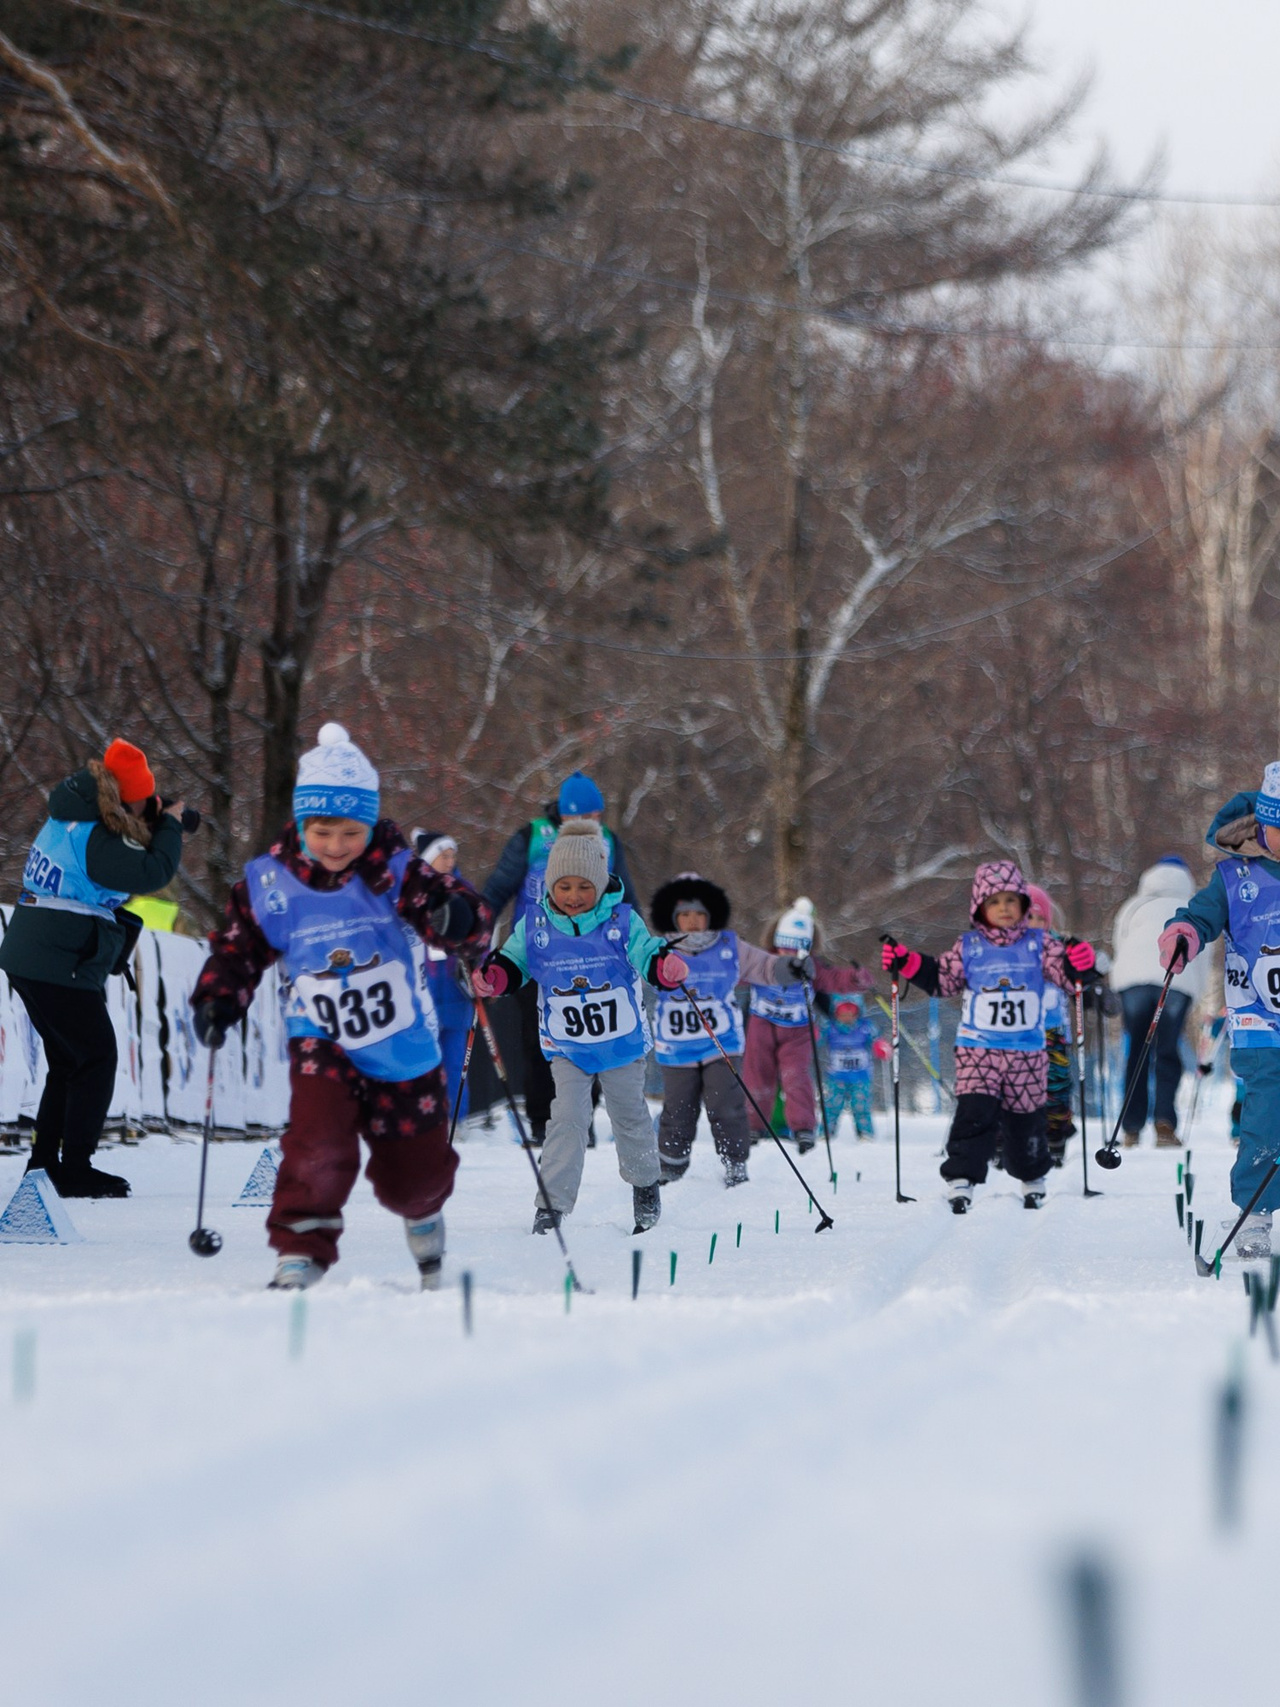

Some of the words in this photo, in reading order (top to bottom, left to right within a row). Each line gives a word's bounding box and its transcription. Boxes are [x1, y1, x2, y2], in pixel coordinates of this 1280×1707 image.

[312, 981, 396, 1042] 933
[562, 998, 618, 1038] 967
[988, 999, 1027, 1027] 731
